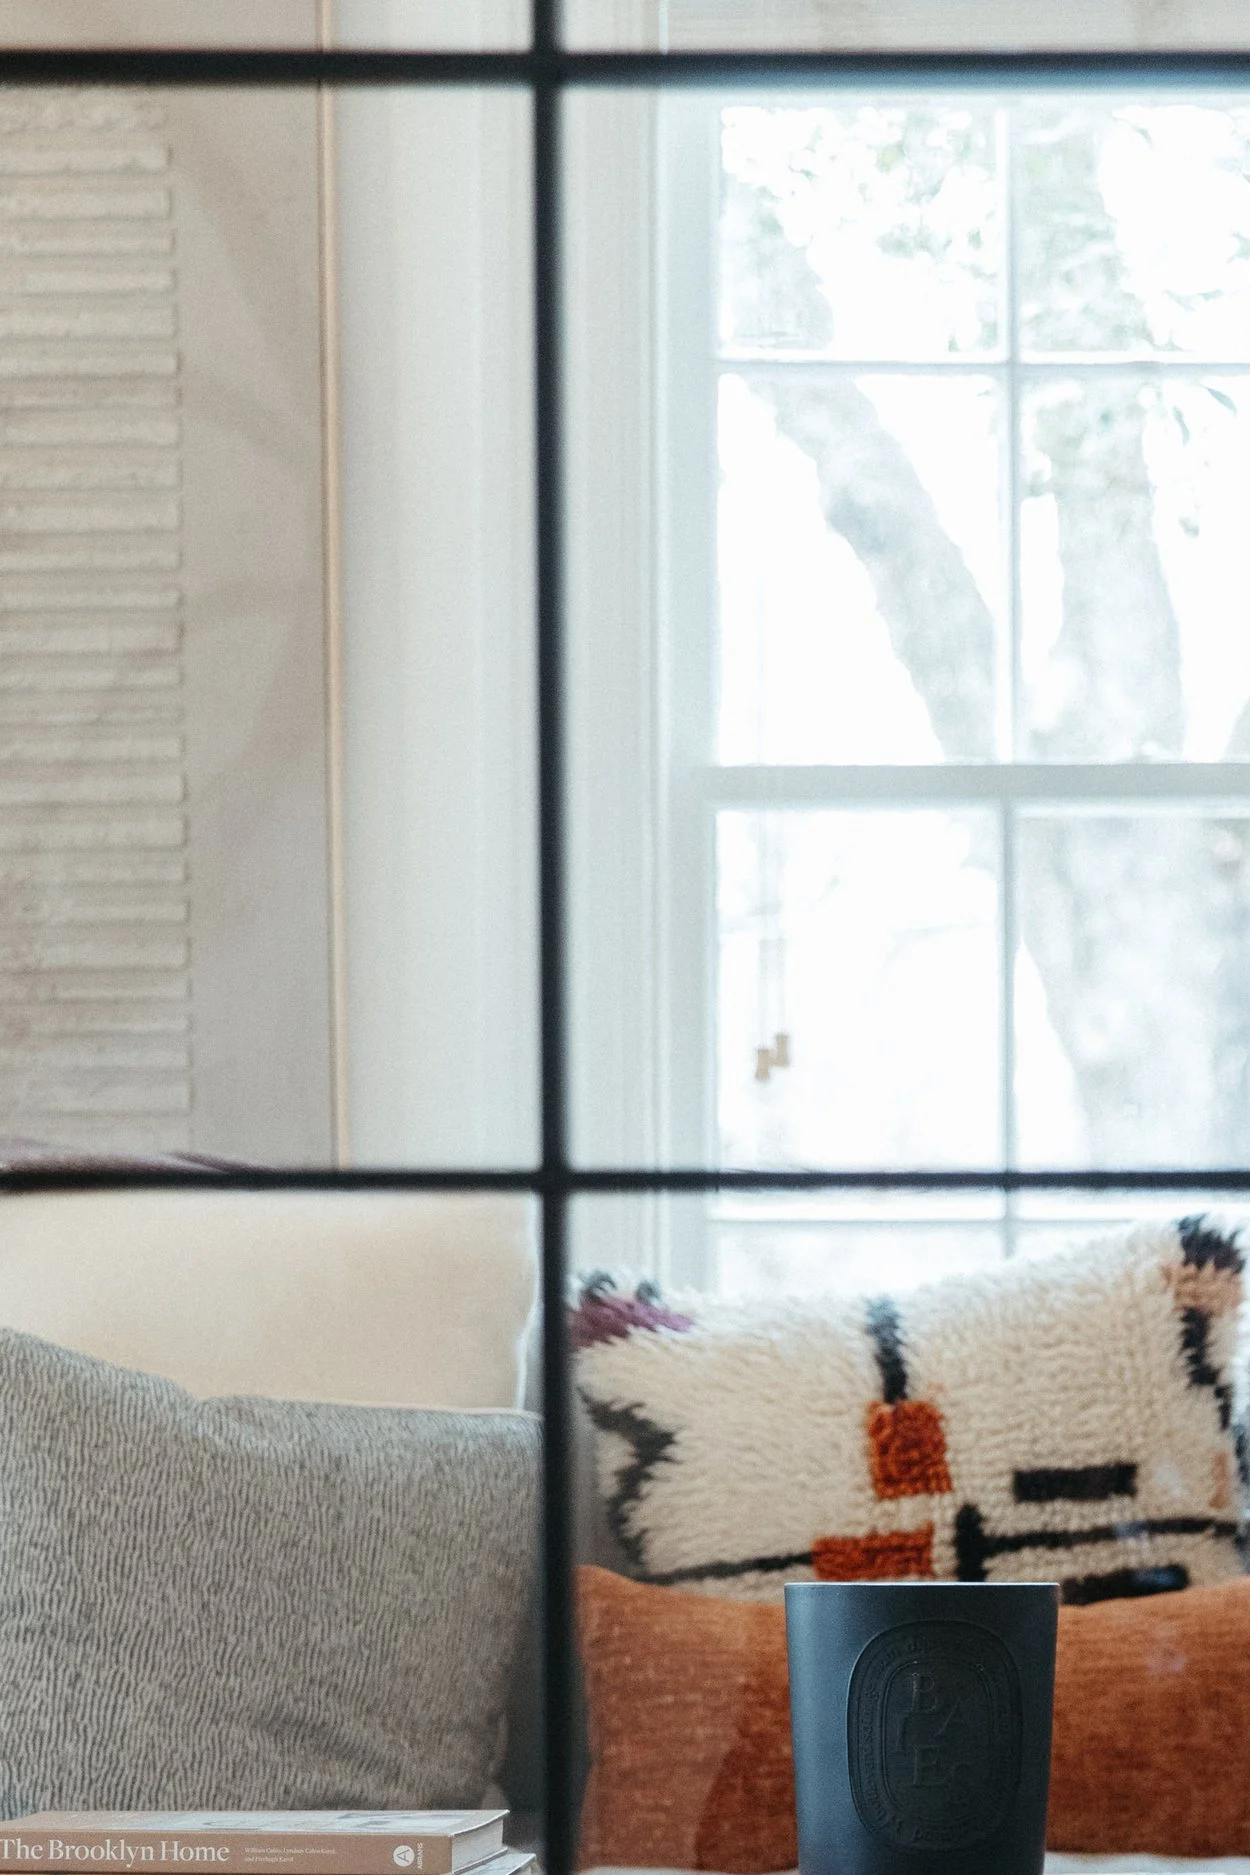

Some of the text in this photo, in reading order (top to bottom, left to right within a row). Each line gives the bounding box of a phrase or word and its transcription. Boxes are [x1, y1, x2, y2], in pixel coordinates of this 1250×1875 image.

[0, 1838, 230, 1868] The Brooklyn Home
